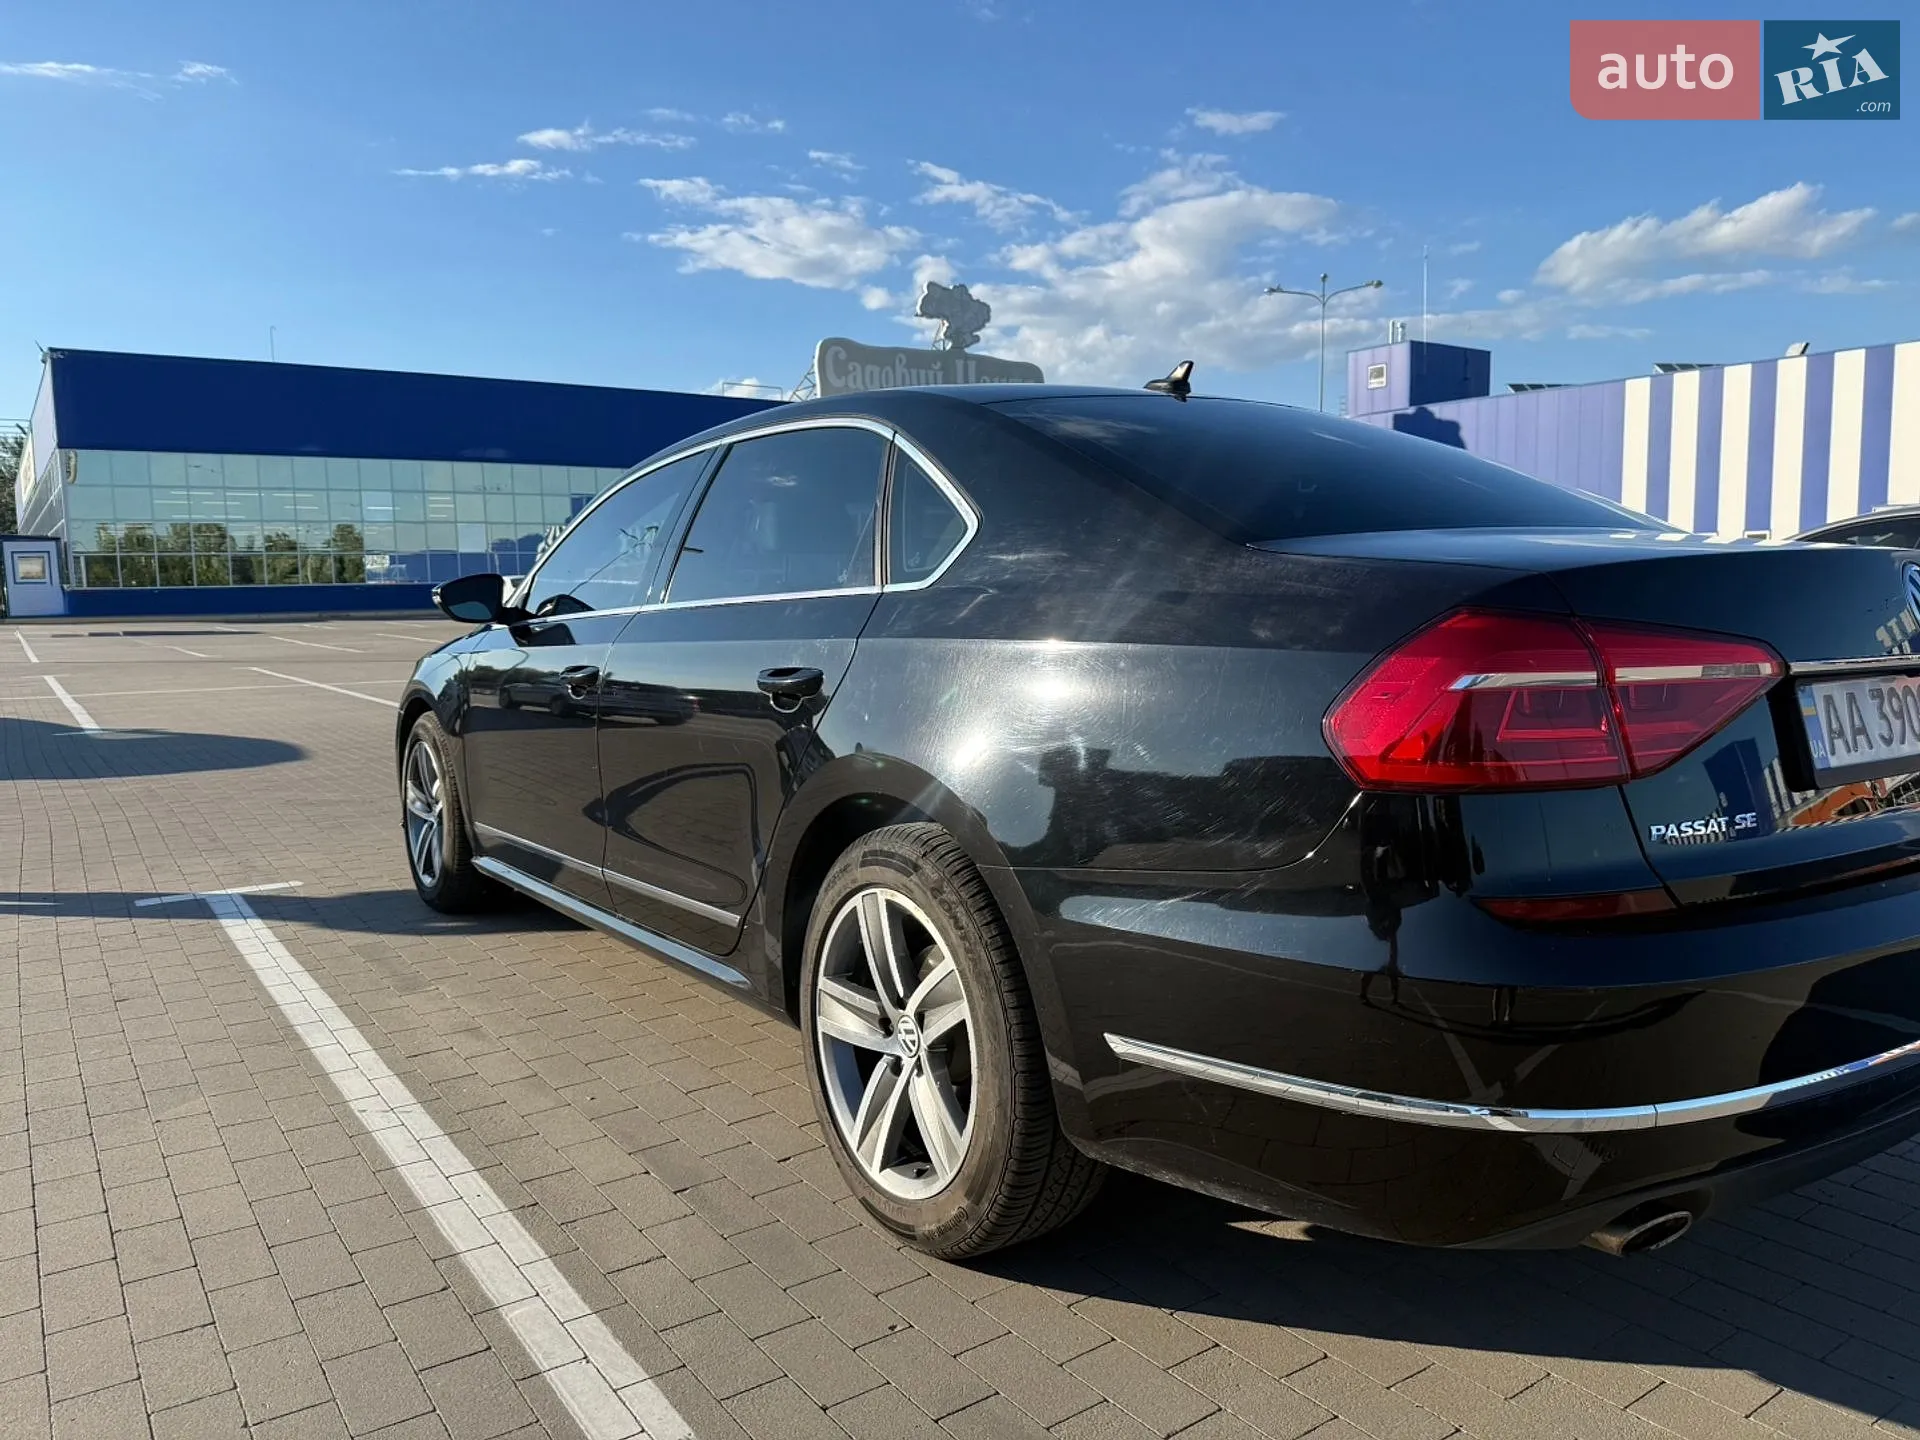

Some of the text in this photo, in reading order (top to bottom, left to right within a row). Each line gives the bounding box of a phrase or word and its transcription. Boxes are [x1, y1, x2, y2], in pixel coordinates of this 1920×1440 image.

[1823, 684, 1920, 756] AA 390
[1650, 812, 1757, 841] PASSAT SE
